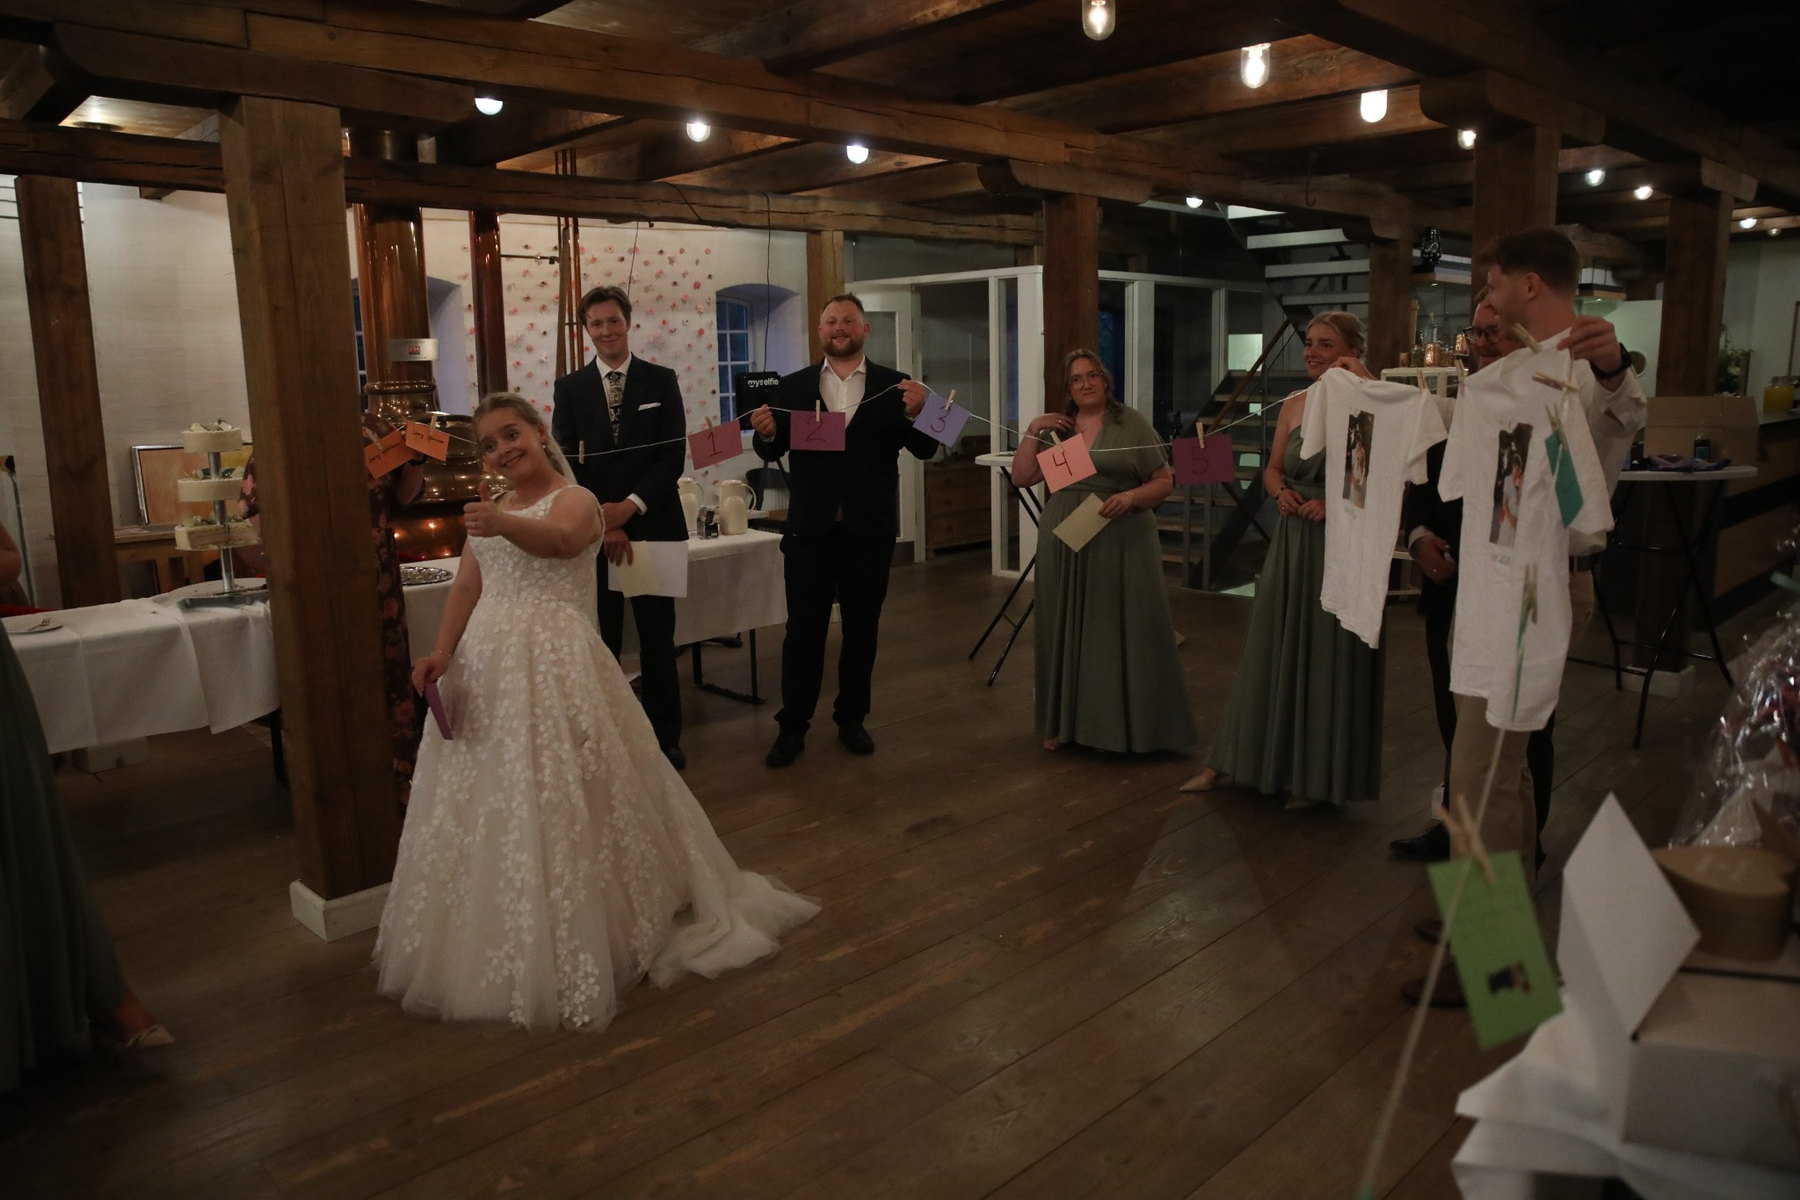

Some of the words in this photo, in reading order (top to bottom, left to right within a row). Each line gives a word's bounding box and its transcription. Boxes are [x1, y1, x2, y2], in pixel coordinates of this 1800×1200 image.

[805, 415, 827, 443] 2
[930, 404, 951, 433] 3
[706, 431, 722, 457] 1
[1052, 450, 1073, 476] 4
[1192, 445, 1209, 475] 5
